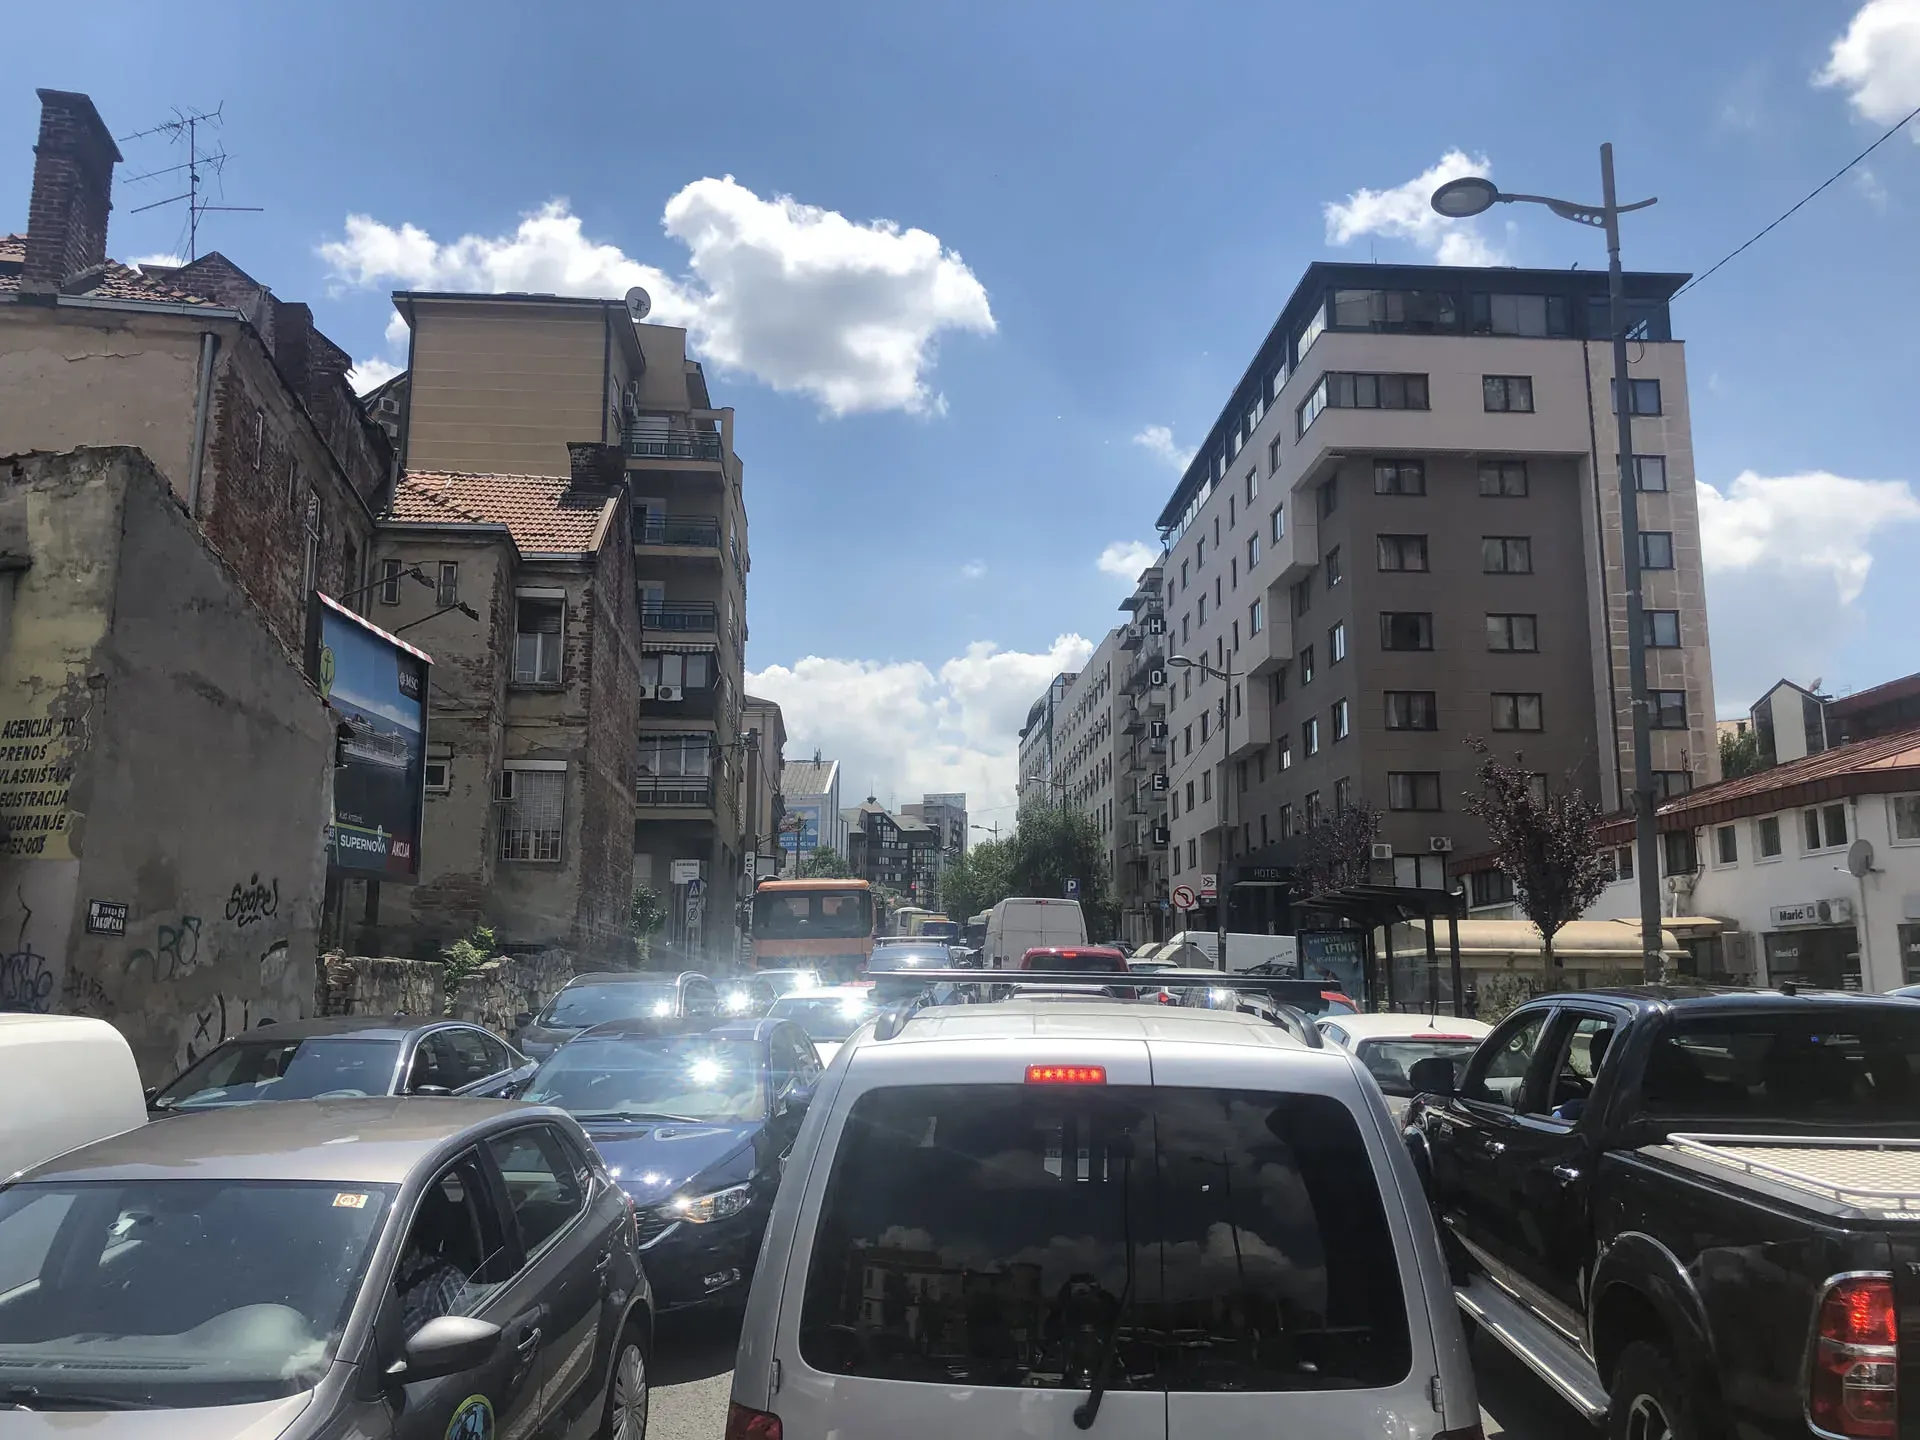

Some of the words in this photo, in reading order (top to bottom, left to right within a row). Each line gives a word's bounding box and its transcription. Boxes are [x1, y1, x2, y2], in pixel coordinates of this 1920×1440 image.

[2, 717, 52, 739] AGENCIJA
[1151, 618, 1165, 843] HOTEL
[0, 744, 47, 761] PRENOS
[340, 834, 386, 854] SUPERNOVA
[1254, 869, 1279, 878] HOTEL
[1068, 881, 1076, 892] P
[1780, 909, 1803, 921] Marić
